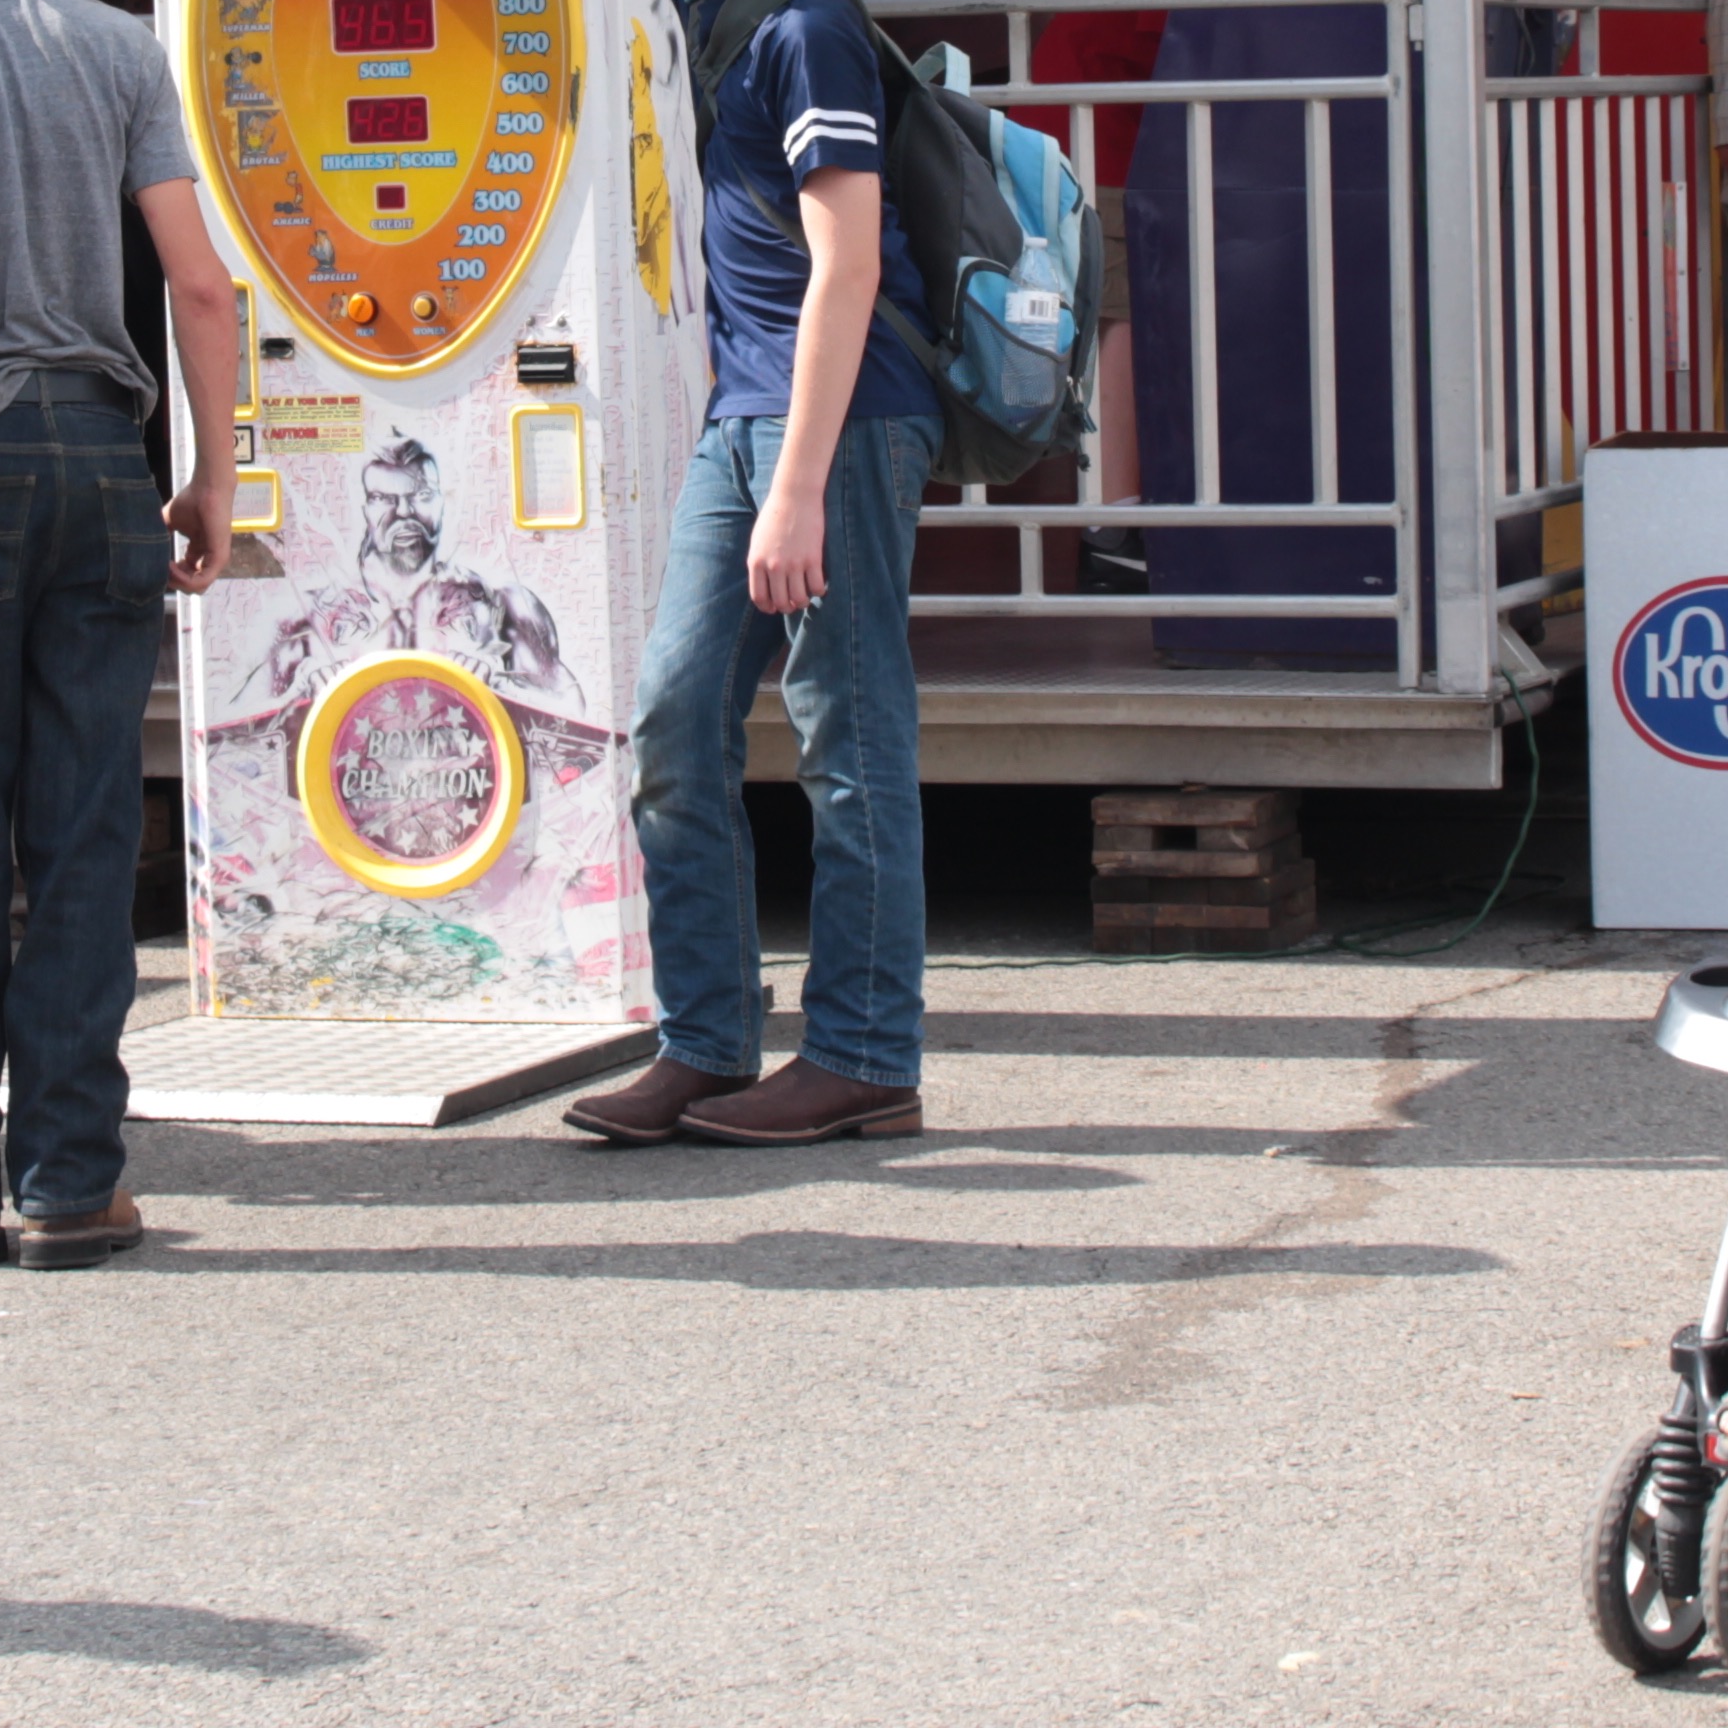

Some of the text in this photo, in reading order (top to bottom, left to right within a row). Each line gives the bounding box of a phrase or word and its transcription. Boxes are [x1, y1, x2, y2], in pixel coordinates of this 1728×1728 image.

[502, 32, 550, 54] 700
[359, 60, 411, 79] SCORE
[501, 72, 549, 94] 600
[231, 92, 266, 101] KILLER
[495, 112, 544, 135] 500
[242, 156, 281, 166] BRUTAL
[321, 150, 458, 171] HIGHEST SCORE
[486, 150, 534, 174] 400
[473, 190, 521, 212] 300
[273, 217, 312, 226] ANEMIC
[370, 218, 414, 230] CREDIT
[456, 224, 506, 247] 200
[308, 273, 359, 282] HOPELESS
[438, 258, 486, 281] 100
[412, 326, 447, 336] WOMEN
[342, 768, 487, 800] CHAMPION
